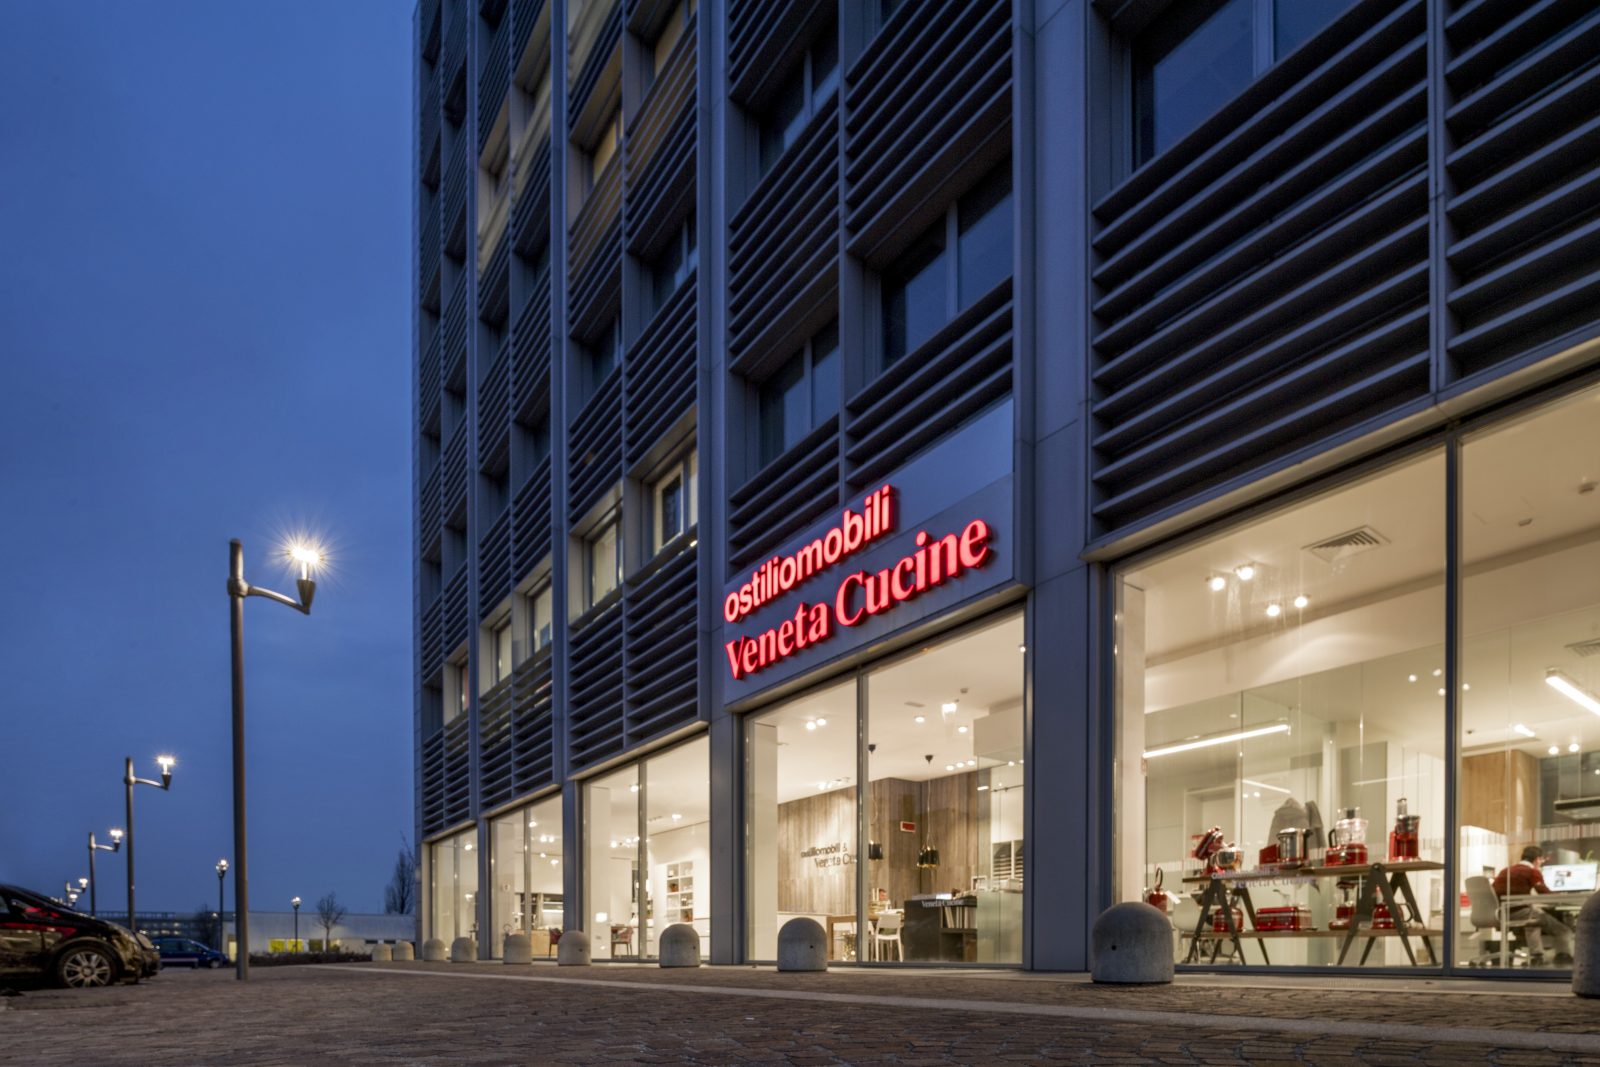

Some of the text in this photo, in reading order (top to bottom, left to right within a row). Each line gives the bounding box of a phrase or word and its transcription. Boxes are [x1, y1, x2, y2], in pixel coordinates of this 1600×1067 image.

[723, 484, 895, 623] ostiliomobili
[725, 519, 991, 680] Veneta Cucine
